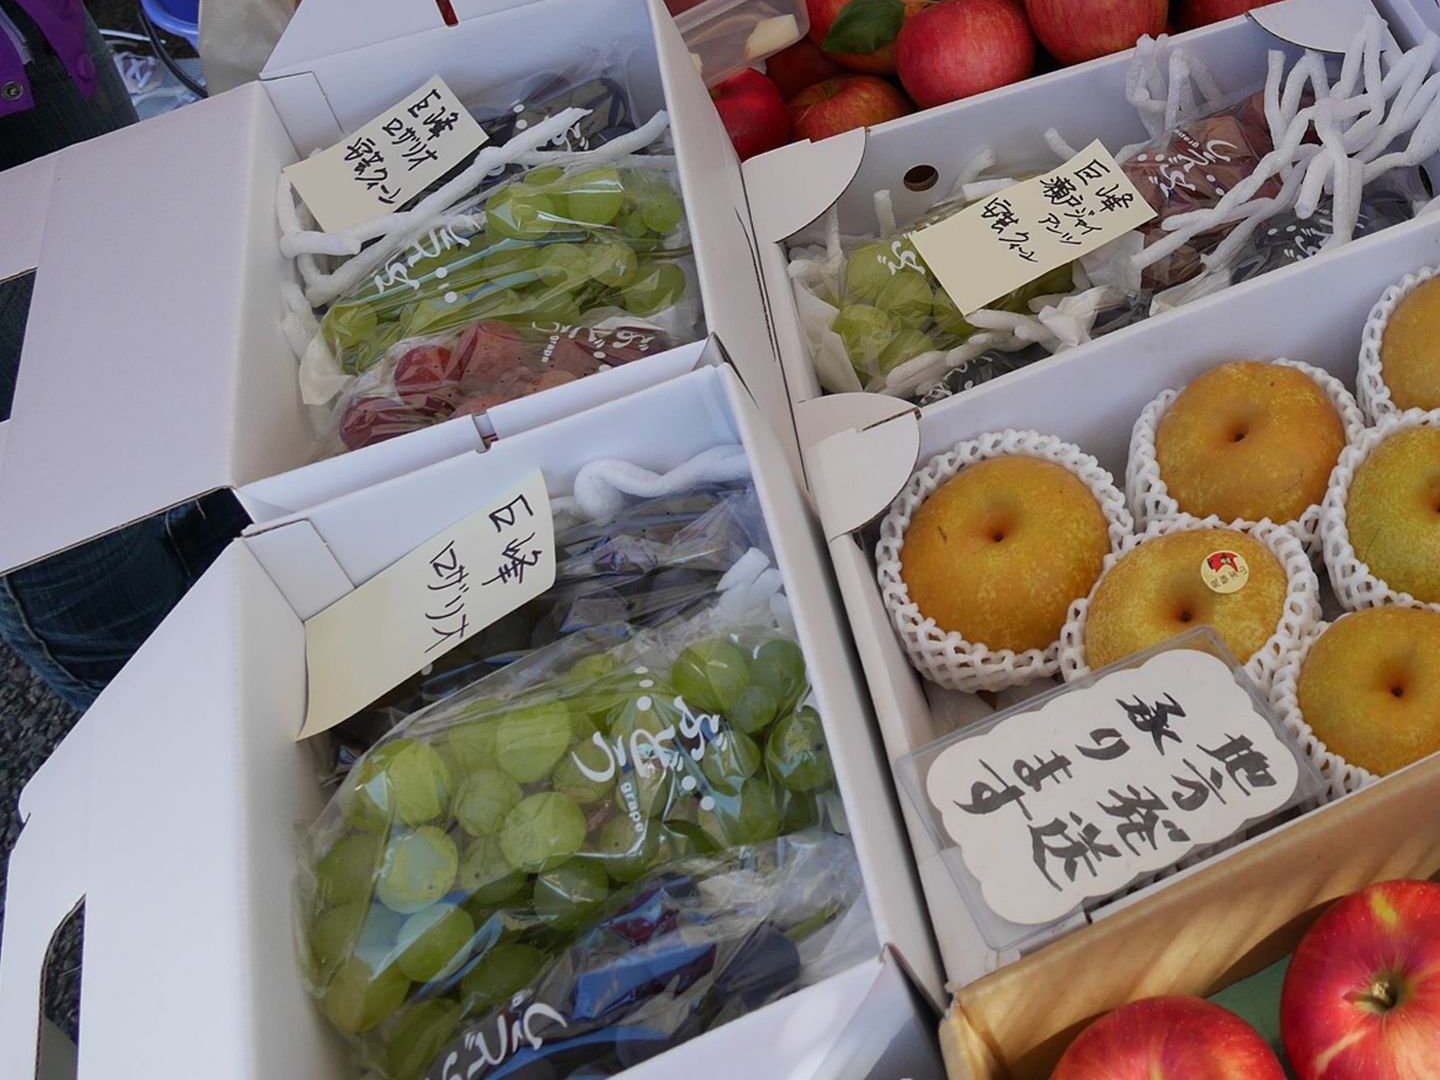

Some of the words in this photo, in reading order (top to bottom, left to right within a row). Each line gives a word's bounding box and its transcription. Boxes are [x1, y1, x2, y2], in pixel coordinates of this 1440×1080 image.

[382, 117, 439, 172] ロザリオ
[407, 88, 459, 141] 巨峰
[1072, 158, 1138, 214] 巨峰
[481, 493, 543, 587] 巨峰
[424, 540, 471, 655] ロザリオ
[570, 694, 729, 785] ぶどう
[619, 780, 647, 835] grape
[1025, 731, 1280, 893] 地方発送
